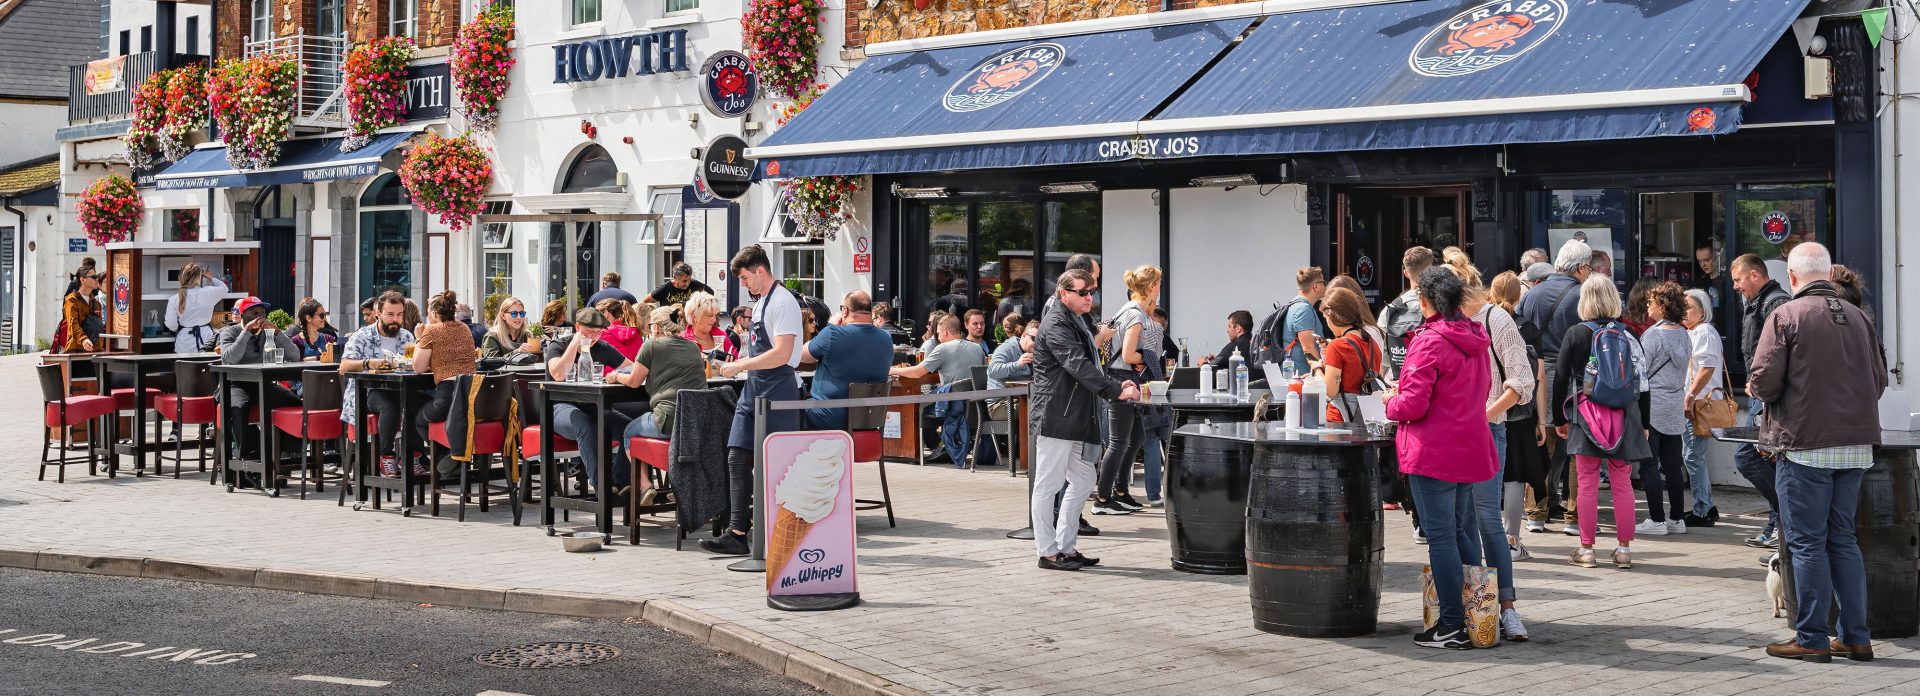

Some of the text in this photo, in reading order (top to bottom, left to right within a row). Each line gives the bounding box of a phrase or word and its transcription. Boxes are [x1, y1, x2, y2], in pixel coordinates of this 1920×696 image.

[1448, 0, 1556, 30] CRABBY
[552, 28, 690, 84] HOWTH
[981, 48, 1056, 73] CRABBY
[711, 56, 752, 79] CRABBY
[724, 93, 746, 112] Jo's
[1098, 136, 1199, 158] CRABBY JO'S
[709, 161, 749, 177] GUINNESS
[1554, 200, 1604, 216] Menu
[1764, 213, 1787, 224] CRABBY
[1391, 346, 1407, 355] adid
[781, 564, 843, 588] Mr. Whippy
